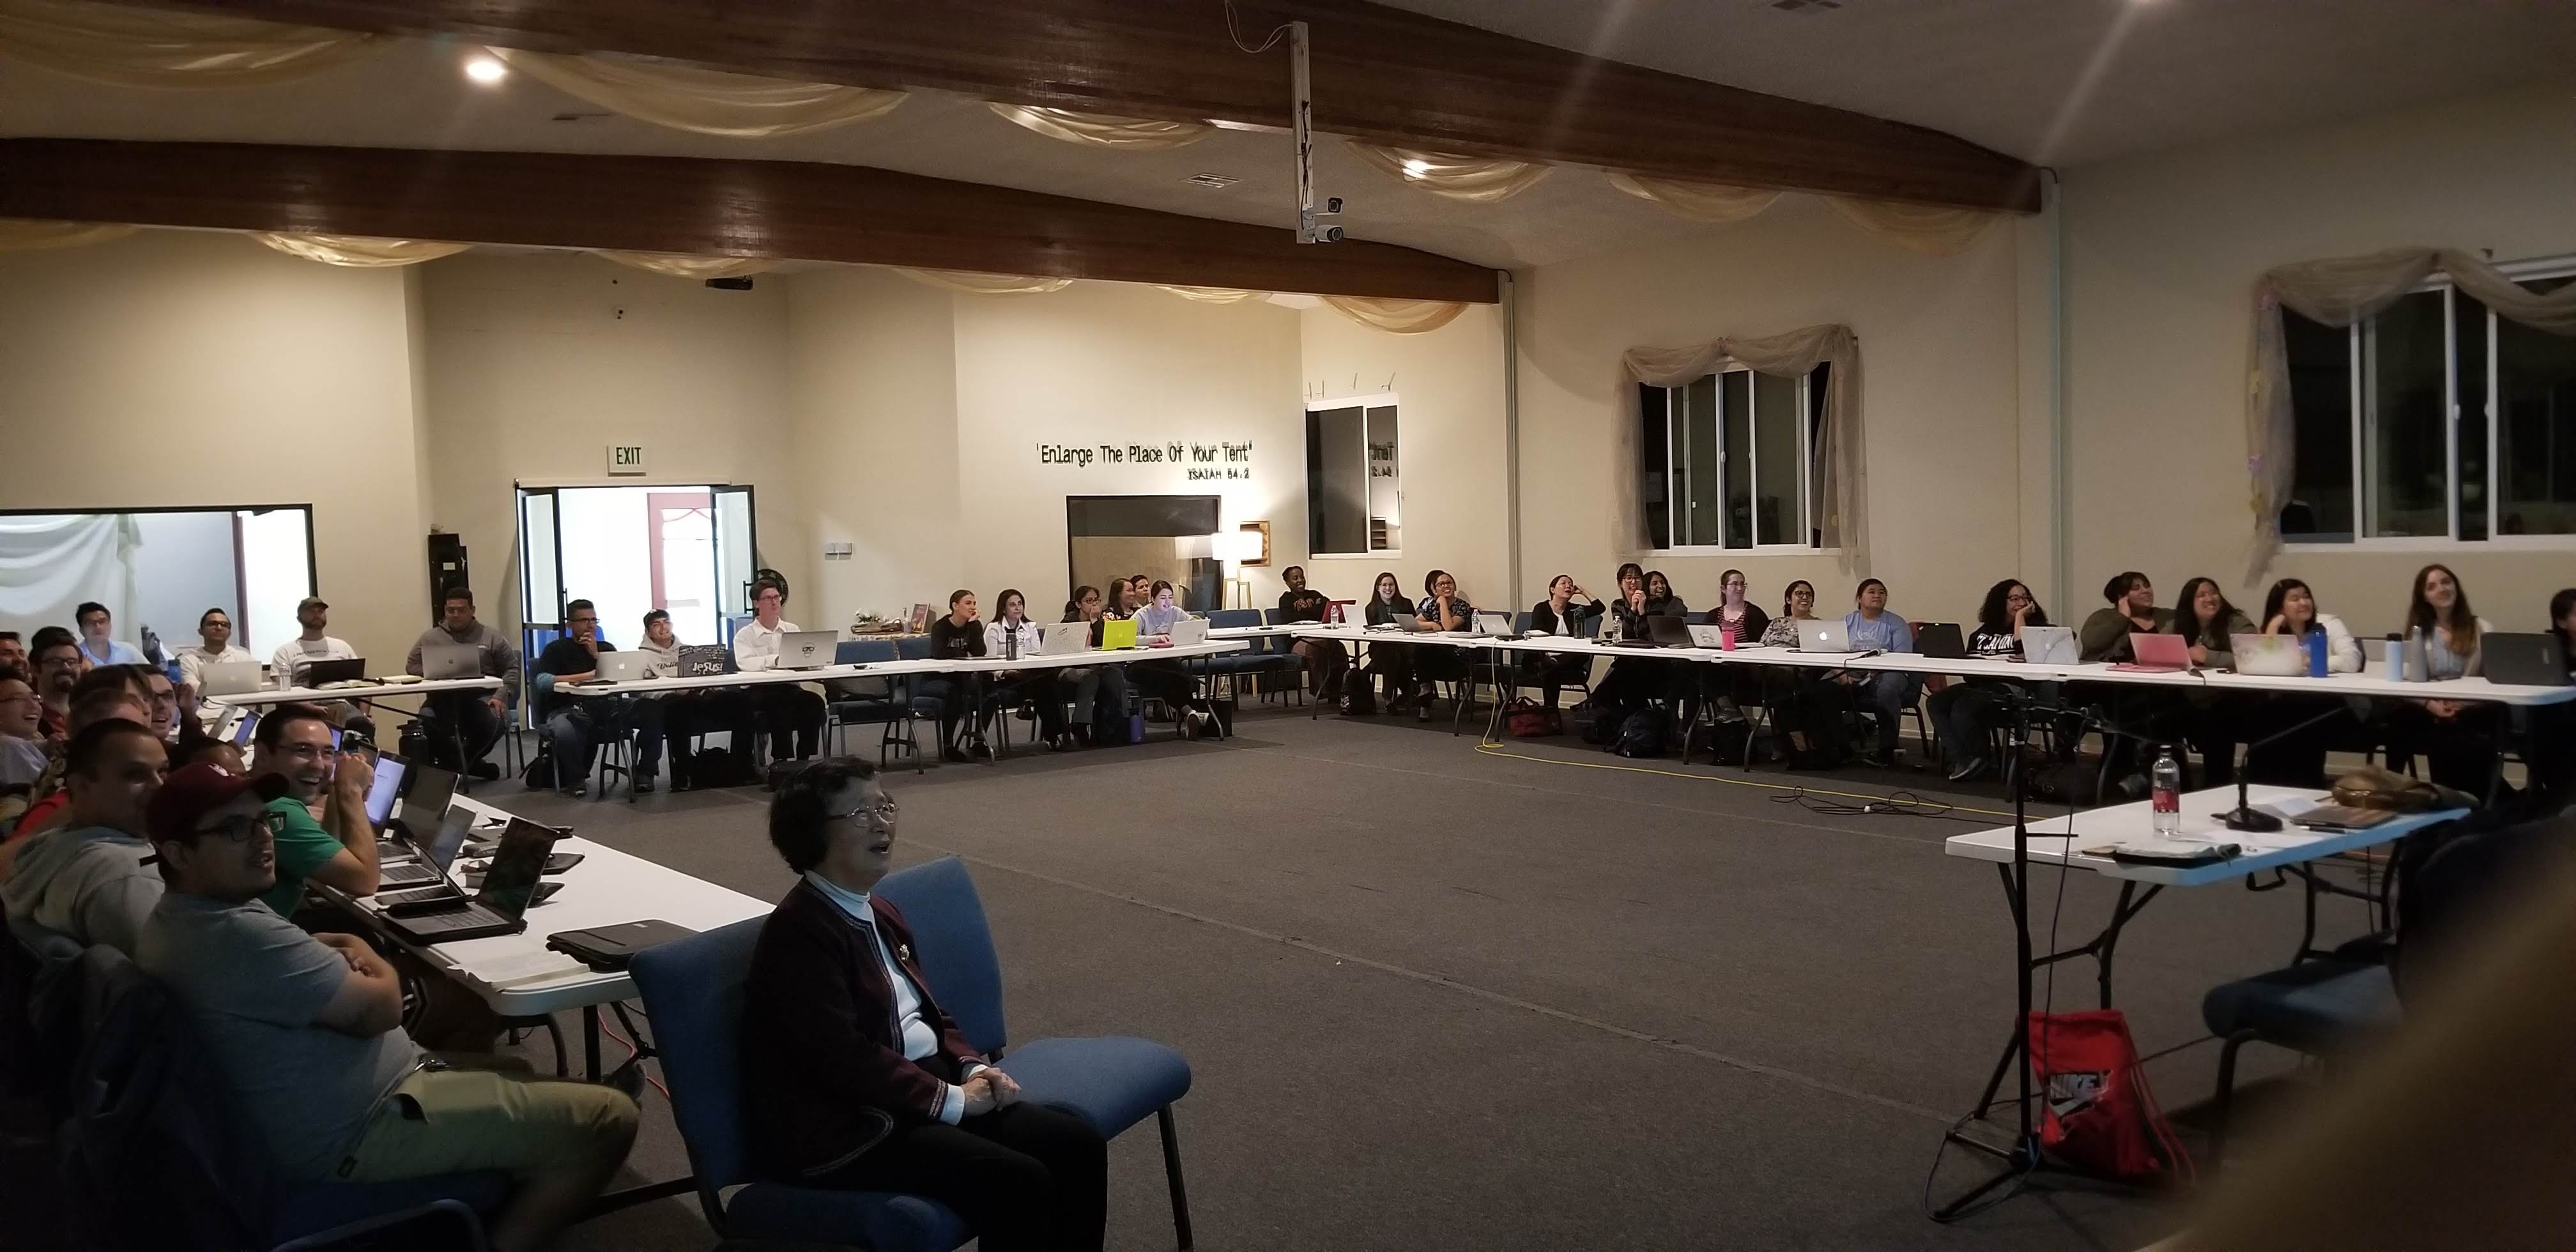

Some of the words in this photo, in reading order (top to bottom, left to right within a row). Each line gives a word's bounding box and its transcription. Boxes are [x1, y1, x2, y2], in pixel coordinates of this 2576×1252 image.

[616, 447, 641, 465] EXIT
[1100, 445, 1123, 464] The
[1128, 445, 1163, 463] Place
[1169, 441, 1184, 462] Of
[1190, 441, 1218, 462] Your
[1187, 468, 1222, 480] ISAIAH
